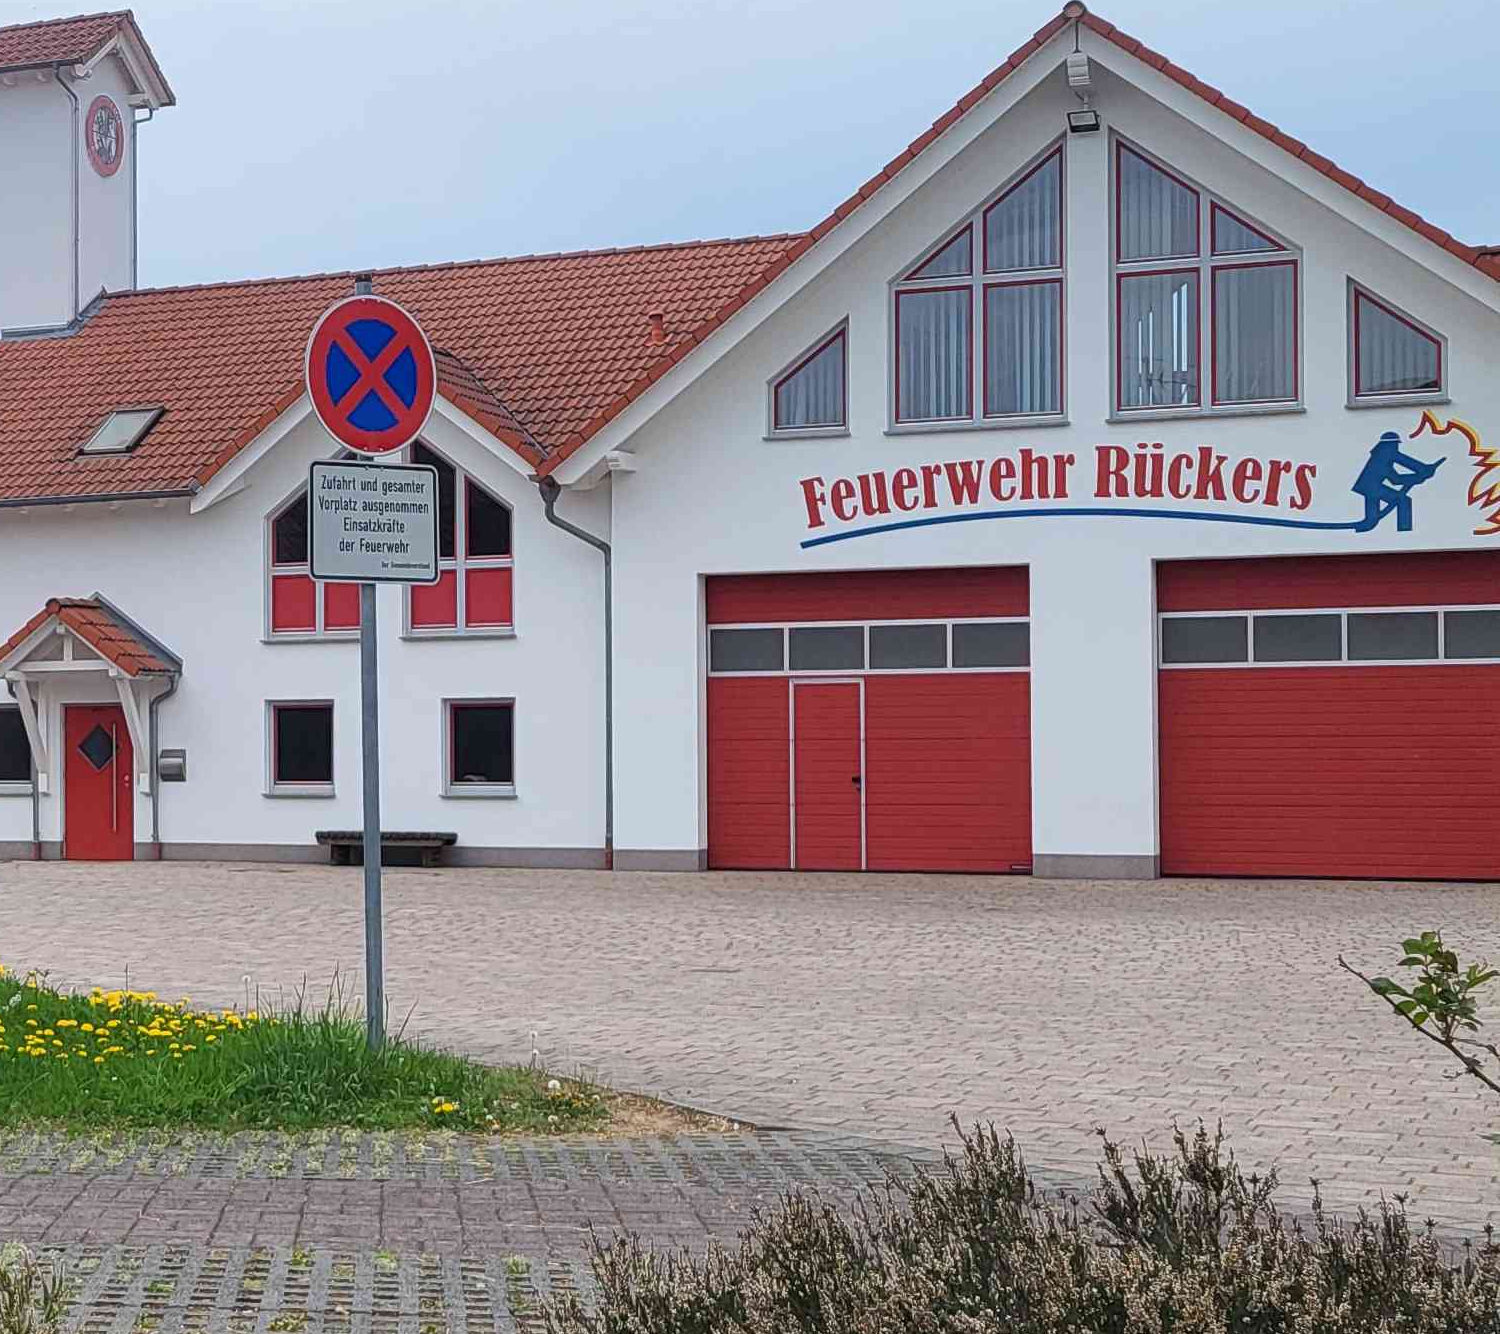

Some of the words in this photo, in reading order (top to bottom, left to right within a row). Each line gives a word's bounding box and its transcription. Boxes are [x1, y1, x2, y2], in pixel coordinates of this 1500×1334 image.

[321, 474, 357, 491] Zufahrt
[360, 477, 378, 492] und
[381, 479, 426, 496] gesamter
[800, 447, 1076, 529] Feuerwehr
[1094, 442, 1317, 511] Rückers
[318, 495, 358, 514] Vorplatz
[362, 499, 429, 515] ausgenommen
[343, 517, 405, 533] Einsatzkräfte
[339, 538, 355, 552] der
[359, 538, 410, 554] Feuerwehr
